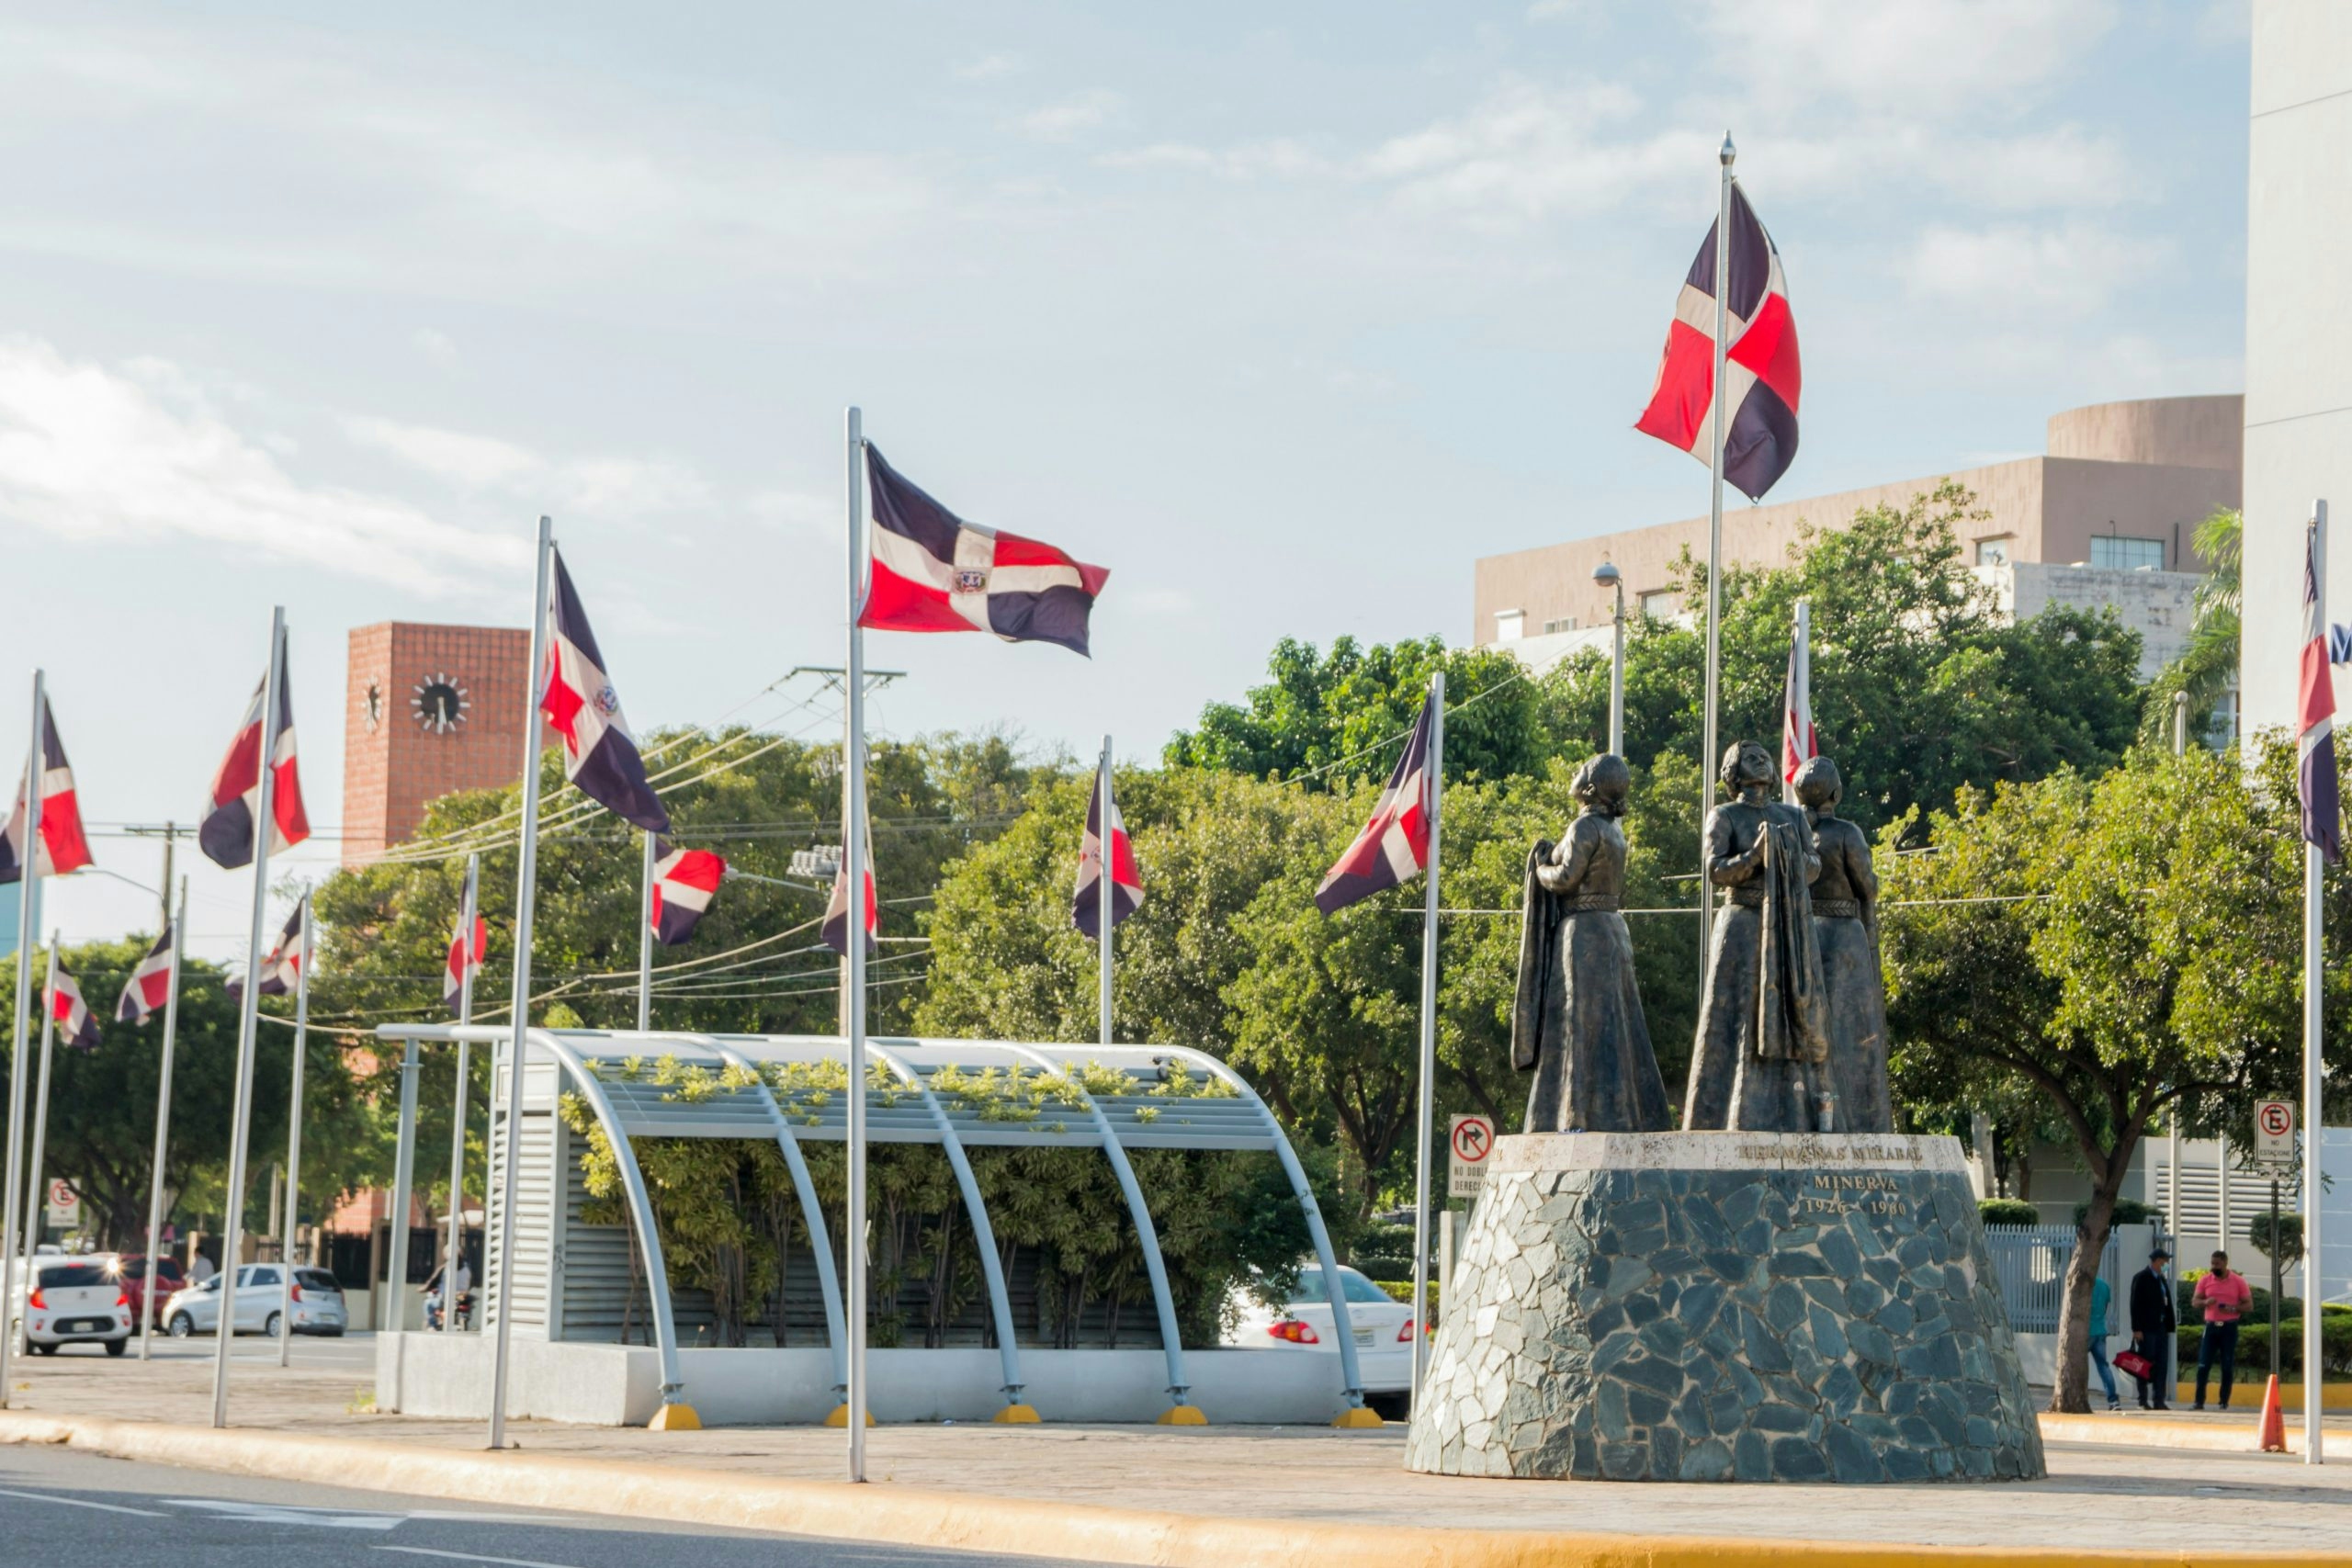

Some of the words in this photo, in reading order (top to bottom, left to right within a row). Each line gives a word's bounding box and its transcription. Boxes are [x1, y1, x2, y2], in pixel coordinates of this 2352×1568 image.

[1851, 1145, 1923, 1161] MIRABAL
[1453, 1166, 1464, 1176] NO
[1814, 1175, 1898, 1190] MINERVA
[1806, 1198, 1846, 1213] 1926
[1871, 1200, 1906, 1215] 1960
